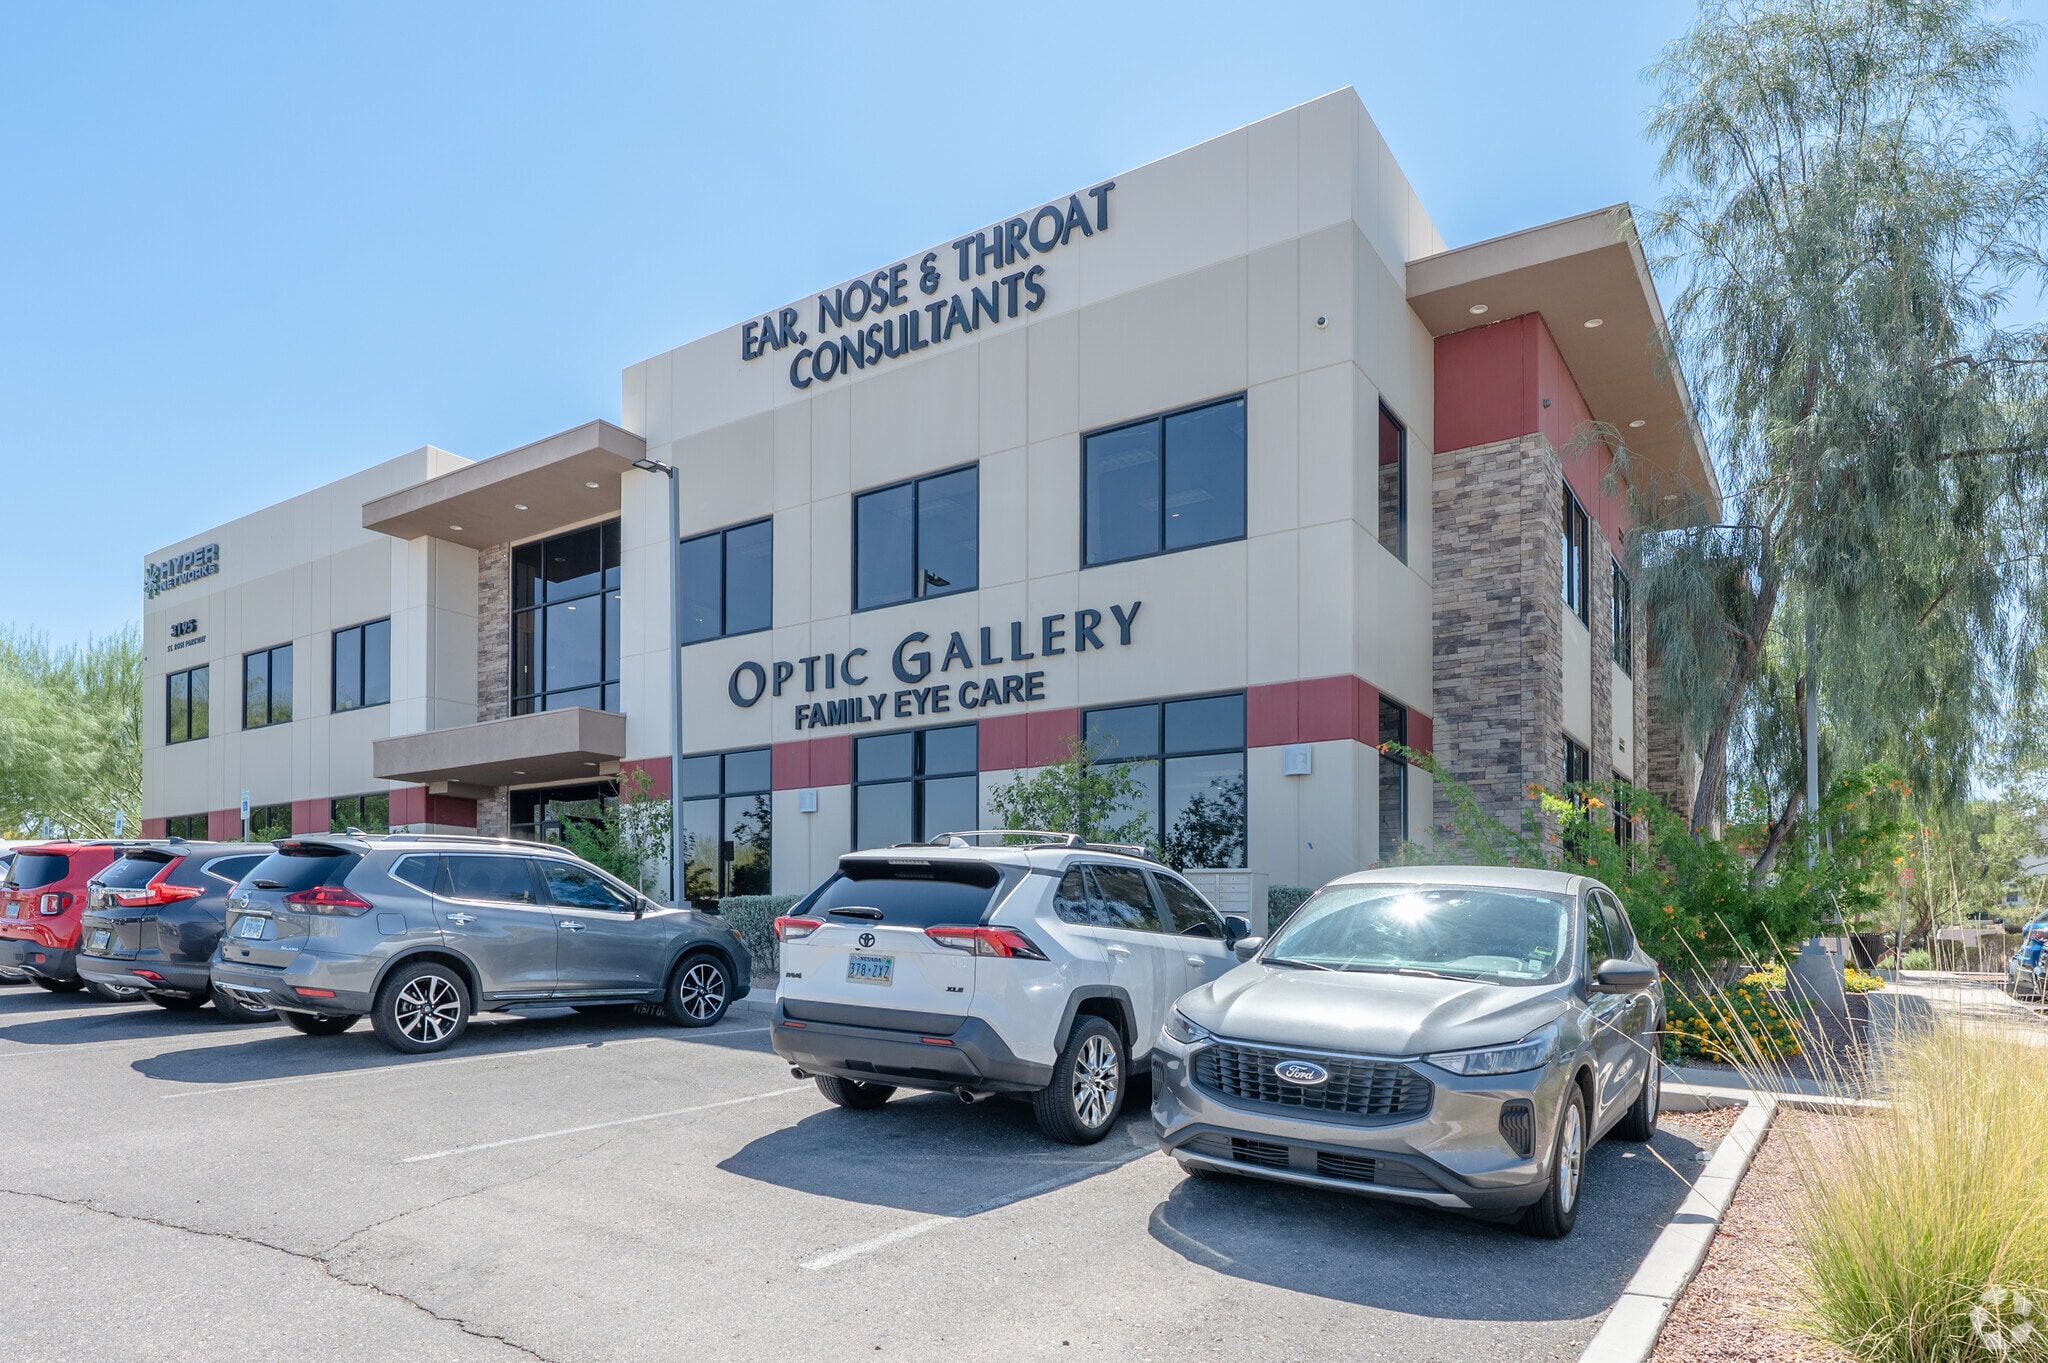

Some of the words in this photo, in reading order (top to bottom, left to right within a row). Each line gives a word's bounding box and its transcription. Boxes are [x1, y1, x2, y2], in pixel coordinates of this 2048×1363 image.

[741, 307, 807, 361] EAR,
[818, 263, 908, 333] NOSE
[919, 252, 941, 295] &
[952, 181, 1116, 281] THROAT
[789, 264, 1046, 389] CONSULTANTS
[159, 563, 219, 591] NETWORKS
[160, 543, 219, 579] HYPER
[171, 619, 197, 637] 3195
[728, 647, 868, 708] OPTIC
[892, 601, 1141, 683] GALLERY
[795, 693, 887, 730] FAMILY
[894, 684, 950, 718] EYE
[958, 671, 1045, 709] CARE
[1286, 1065, 1314, 1079] Ford
